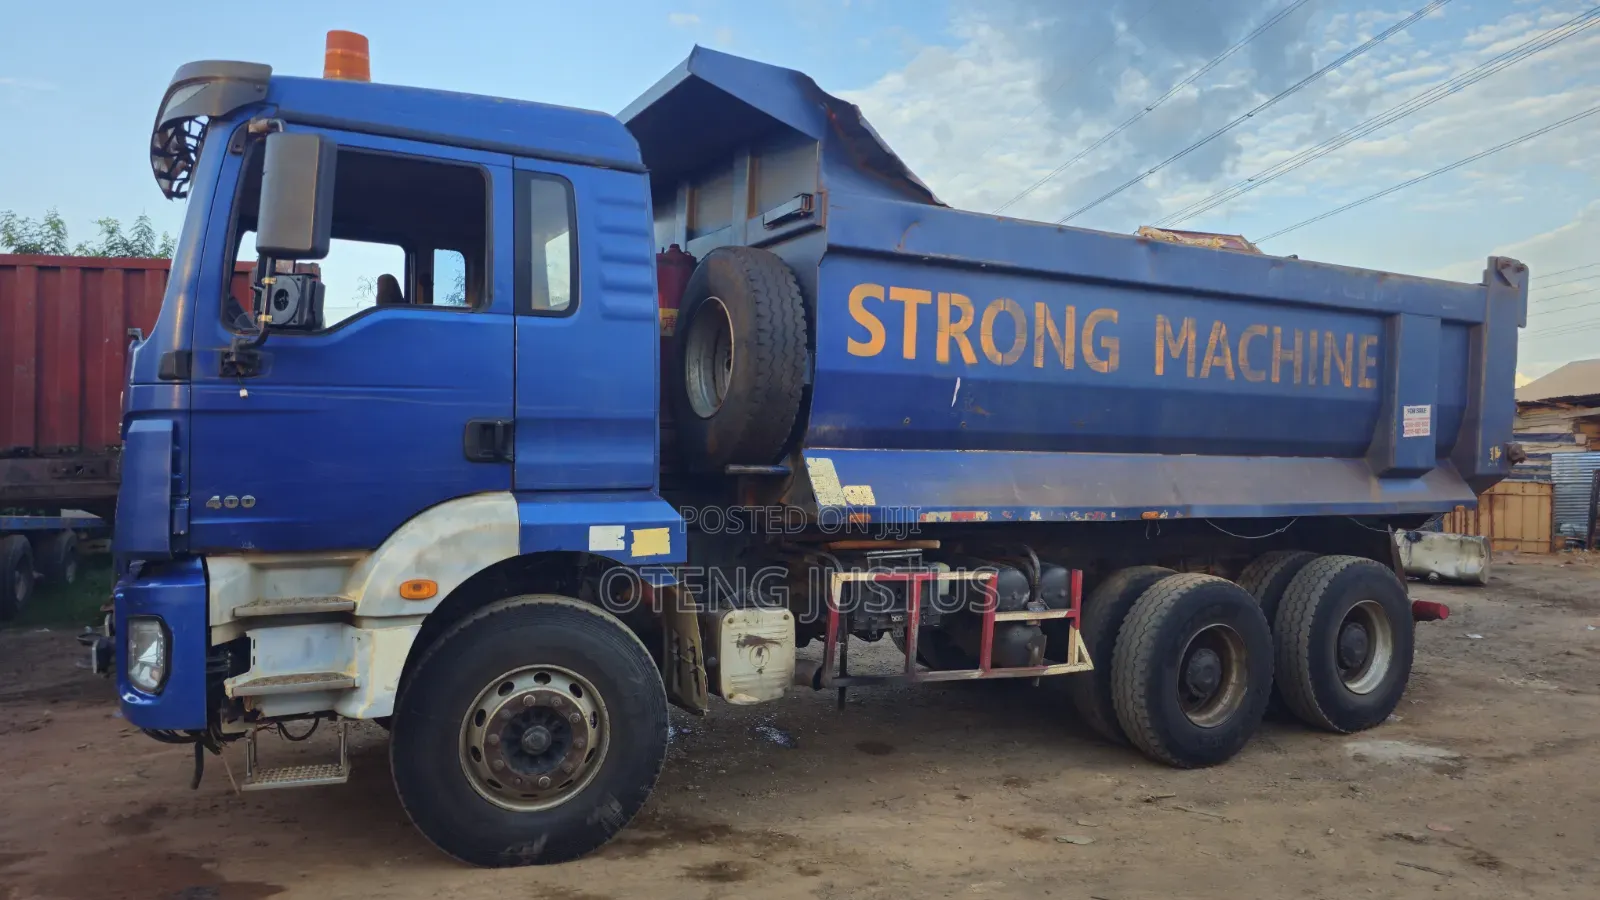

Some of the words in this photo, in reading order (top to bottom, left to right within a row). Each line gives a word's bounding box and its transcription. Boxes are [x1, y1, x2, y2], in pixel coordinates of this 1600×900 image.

[847, 283, 1120, 373] STRONG
[1154, 314, 1378, 389] MACHINE
[205, 495, 256, 509] 400
